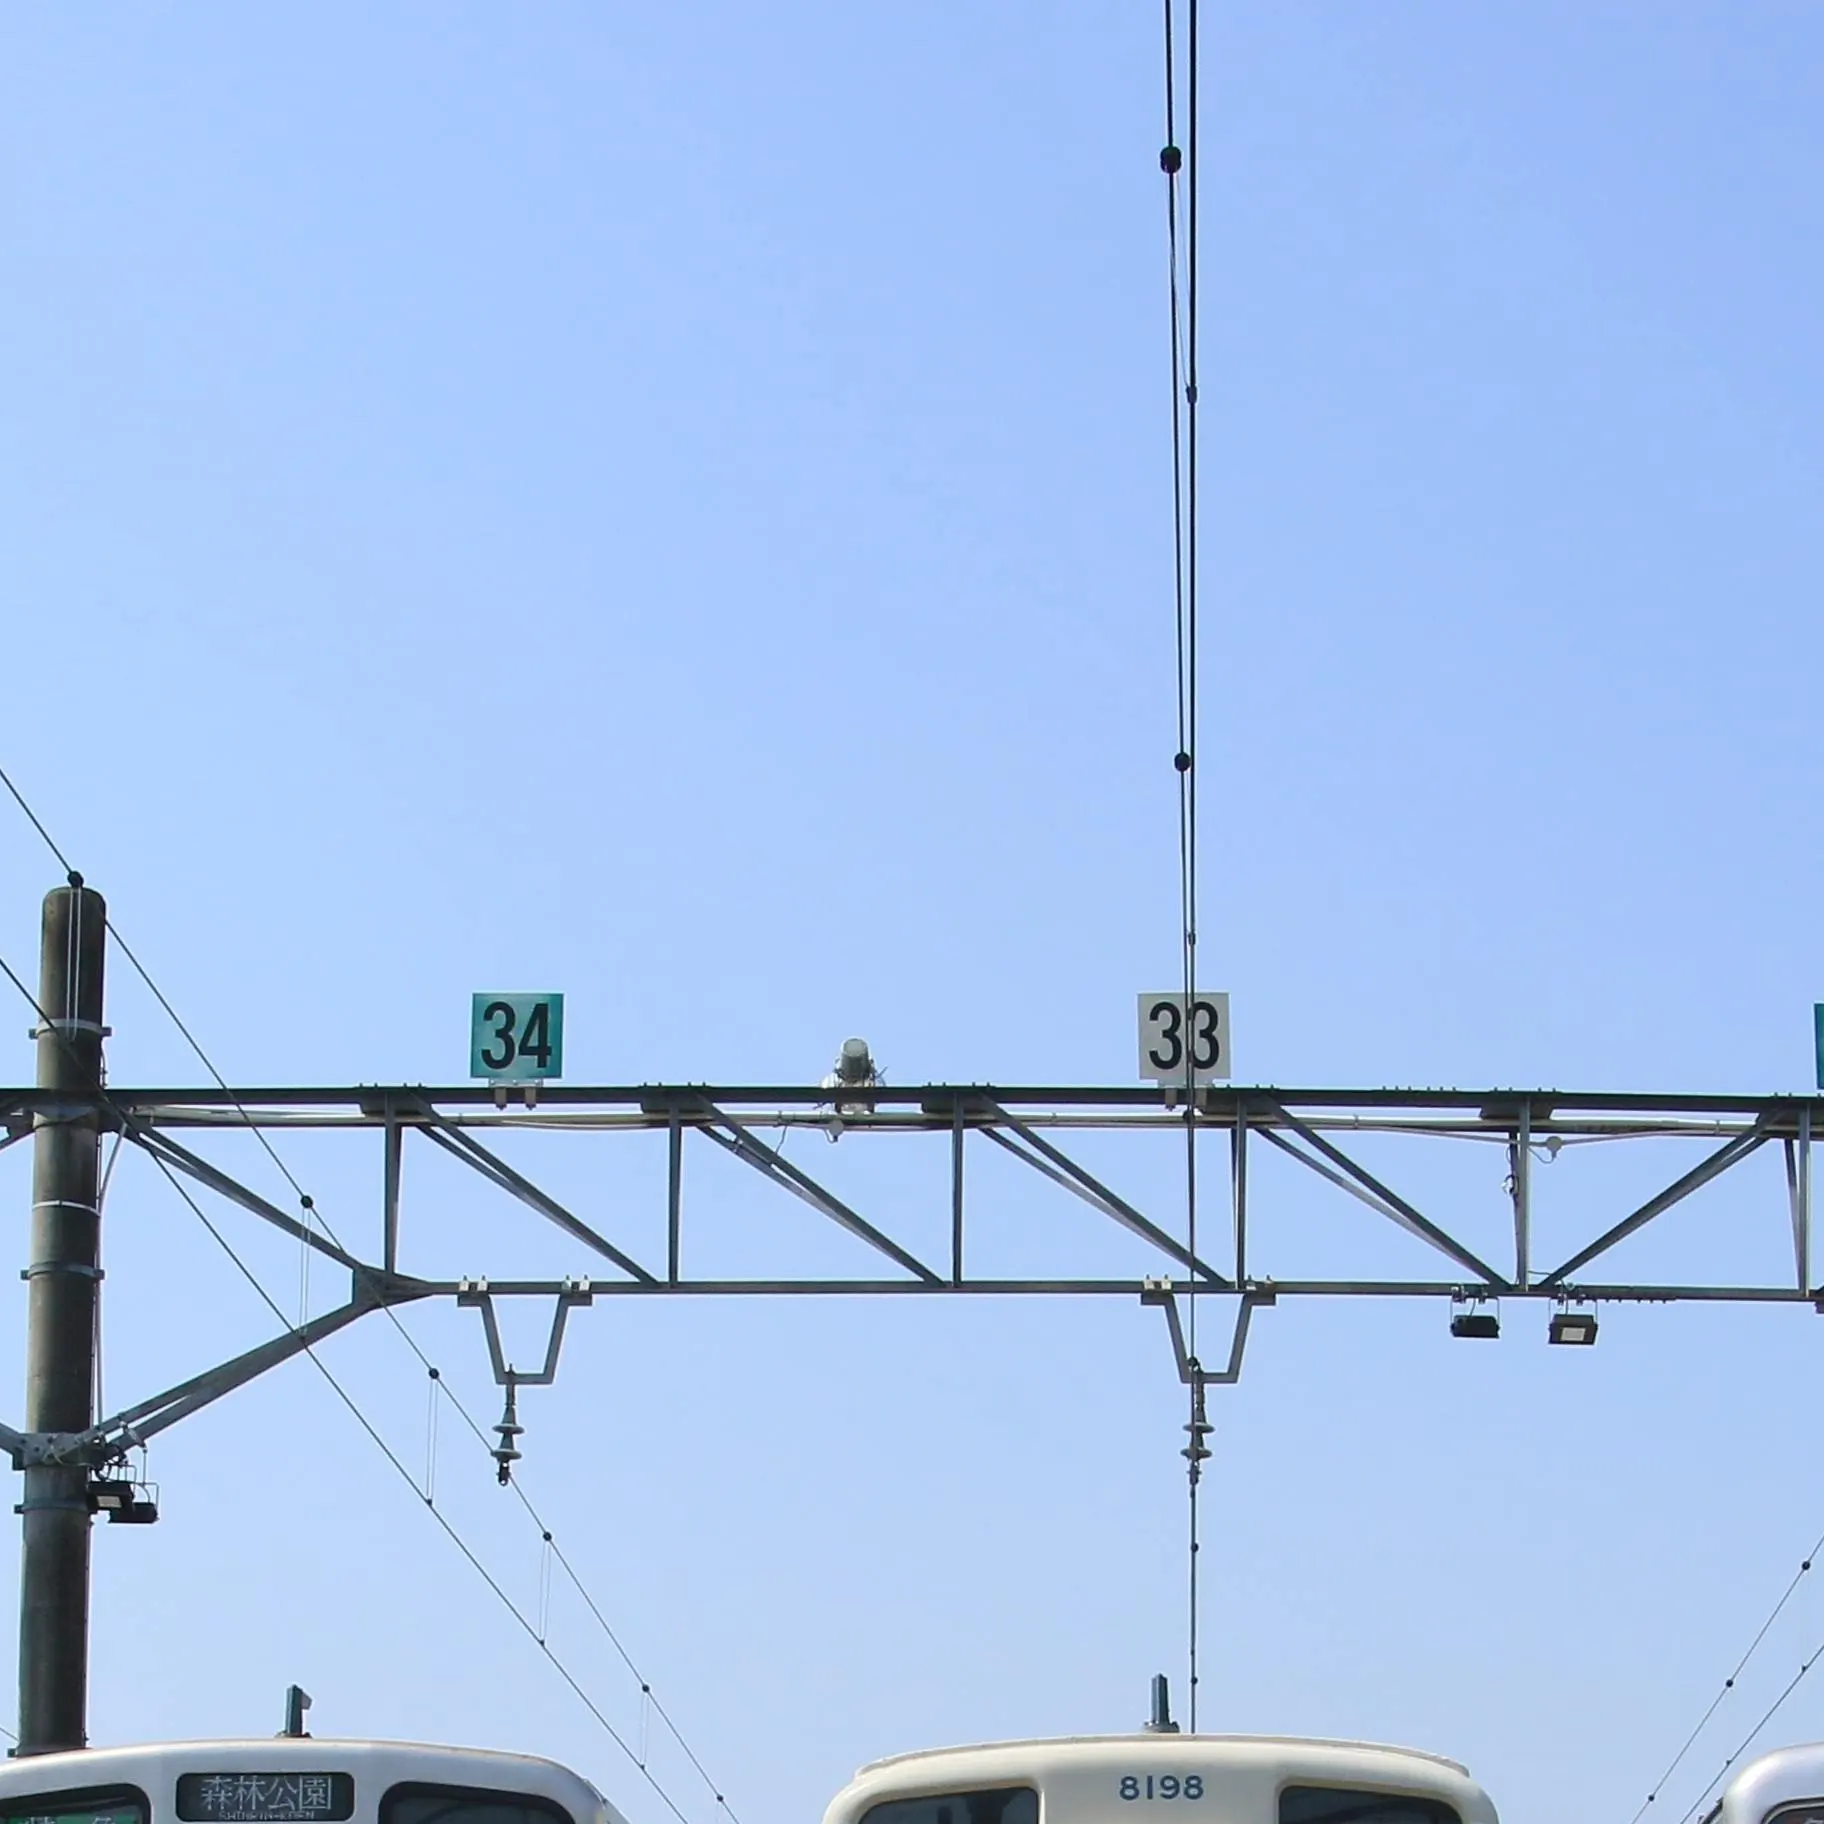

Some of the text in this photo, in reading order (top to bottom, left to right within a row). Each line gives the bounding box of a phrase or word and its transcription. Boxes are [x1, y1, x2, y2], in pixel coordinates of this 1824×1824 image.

[481, 1002, 552, 1069] 34
[1149, 1001, 1219, 1070] 33
[201, 1775, 331, 1810] 森林公園
[1120, 1775, 1204, 1800] 8198
